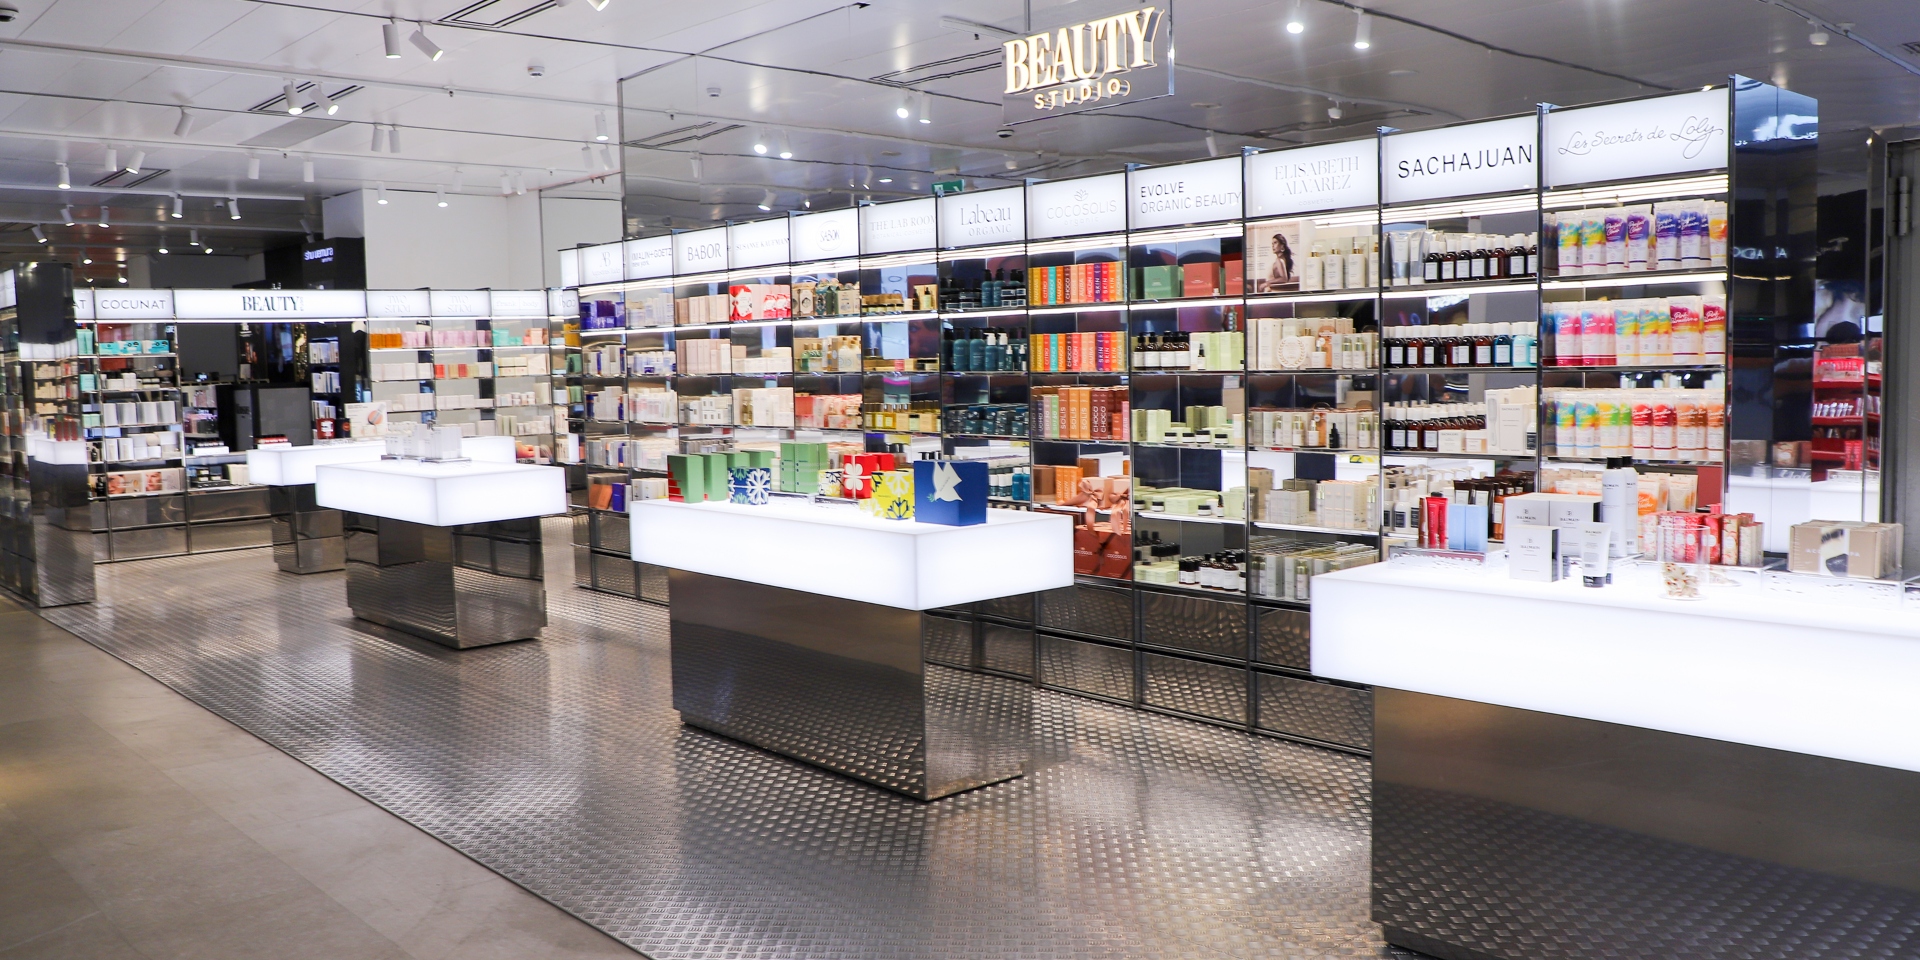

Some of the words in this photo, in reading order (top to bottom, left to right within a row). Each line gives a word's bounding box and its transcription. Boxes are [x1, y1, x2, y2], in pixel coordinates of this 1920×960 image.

[1003, 6, 1157, 94] BEAUTY
[1034, 77, 1127, 110] STUDIO
[1558, 131, 1591, 155] Les
[1591, 128, 1643, 147] Secrets
[1647, 125, 1667, 140] de
[1670, 115, 1725, 160] Loly
[1274, 156, 1360, 180] ELISABETH
[1398, 144, 1532, 178] SACHAJUAN
[1140, 181, 1184, 198] EVOLVE
[1282, 174, 1352, 196] ALVAREZ
[1046, 200, 1117, 219] COCOSOLIS
[1140, 196, 1192, 214] ORGANIC
[1195, 191, 1242, 208] BEAUTY
[871, 219, 888, 232] THE
[891, 215, 909, 230] LAB
[960, 203, 1011, 226] Labeau
[968, 224, 1012, 237] ORGANIC
[687, 243, 722, 262] BABOR
[101, 300, 166, 310] COCUNAT
[242, 296, 299, 311] BEAUTY
